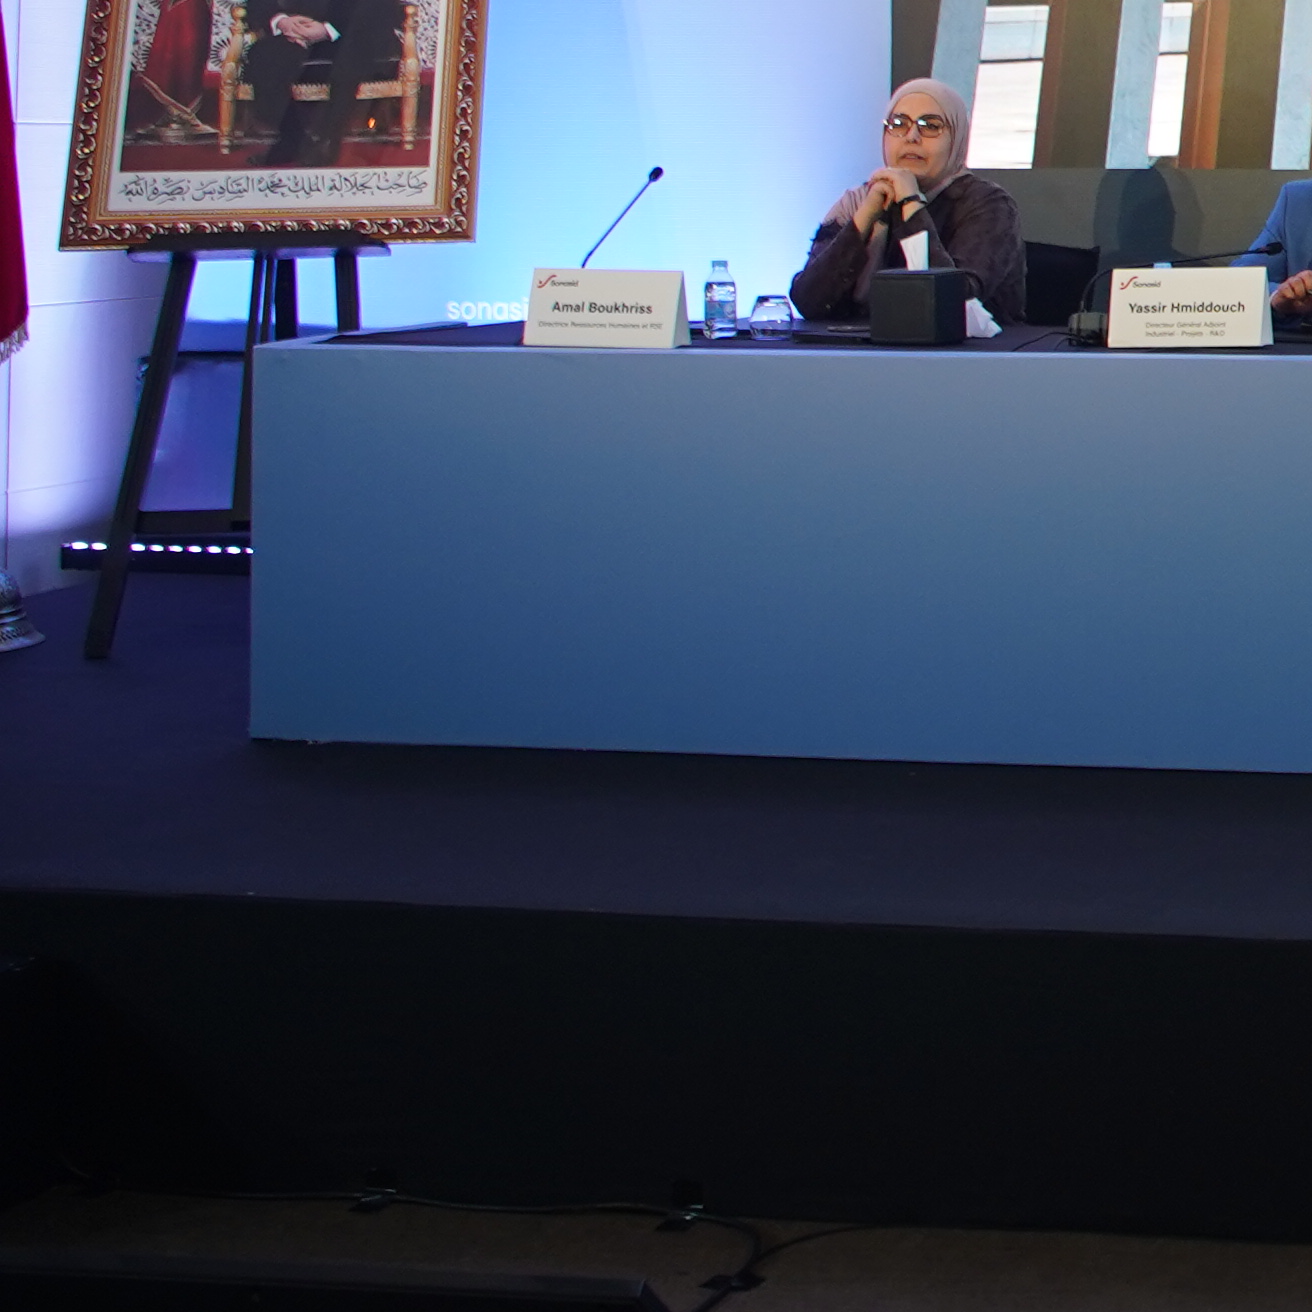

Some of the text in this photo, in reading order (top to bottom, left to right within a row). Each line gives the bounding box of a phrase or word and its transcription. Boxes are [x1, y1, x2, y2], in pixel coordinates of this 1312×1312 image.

[552, 301, 652, 314] Amal Boukhriss
[1129, 302, 1245, 313] Yassir Hmiddouch
